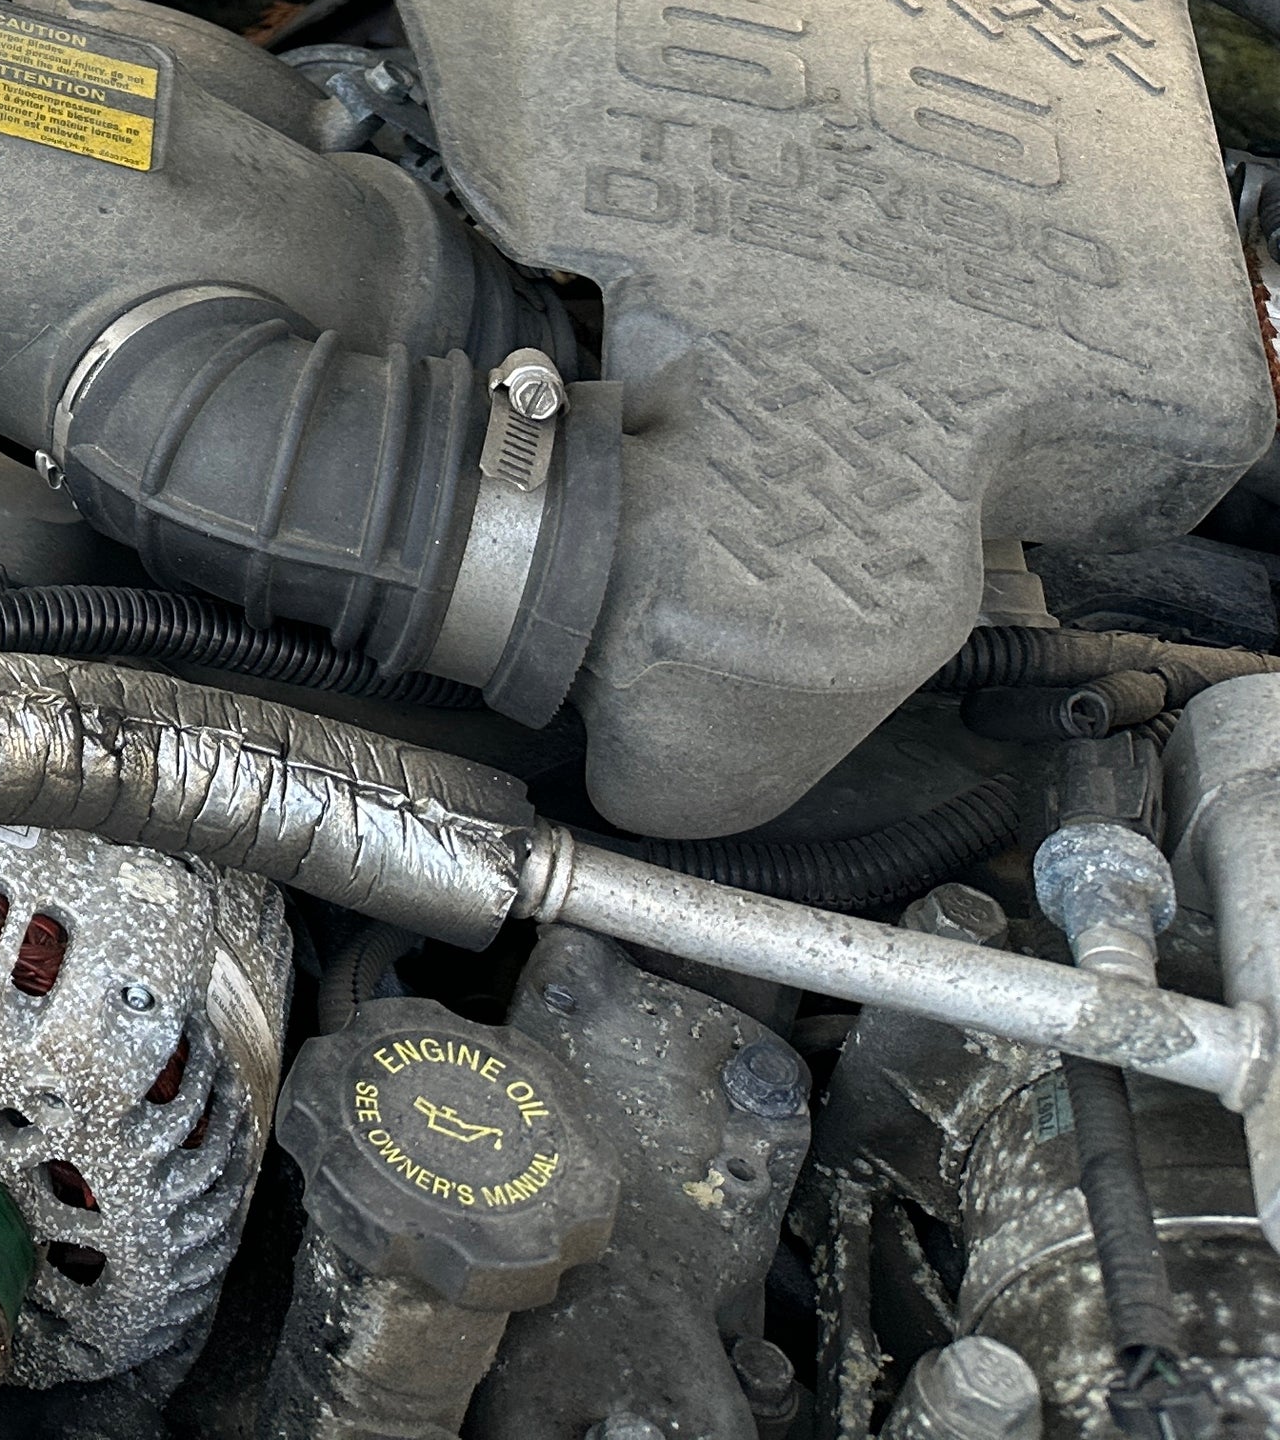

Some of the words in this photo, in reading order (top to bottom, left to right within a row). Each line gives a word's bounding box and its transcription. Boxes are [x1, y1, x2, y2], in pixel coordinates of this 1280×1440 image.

[11, 52, 34, 66] with
[37, 58, 54, 70] the
[57, 65, 80, 78] duct
[25, 48, 72, 66] personal
[127, 74, 145, 85] not
[2, 82, 102, 116] Turbocompresseur
[13, 95, 44, 110] éviter
[47, 104, 63, 116] les
[49, 117, 88, 134] moteur
[604, 104, 1122, 290] TURBO
[584, 163, 1155, 372] DIESEL
[355, 1081, 382, 1123] SEE
[373, 1038, 506, 1083] ENGINE
[506, 1081, 549, 1127] OIL
[368, 1129, 475, 1206] OWNER'S
[481, 1153, 559, 1207] MANUAL
